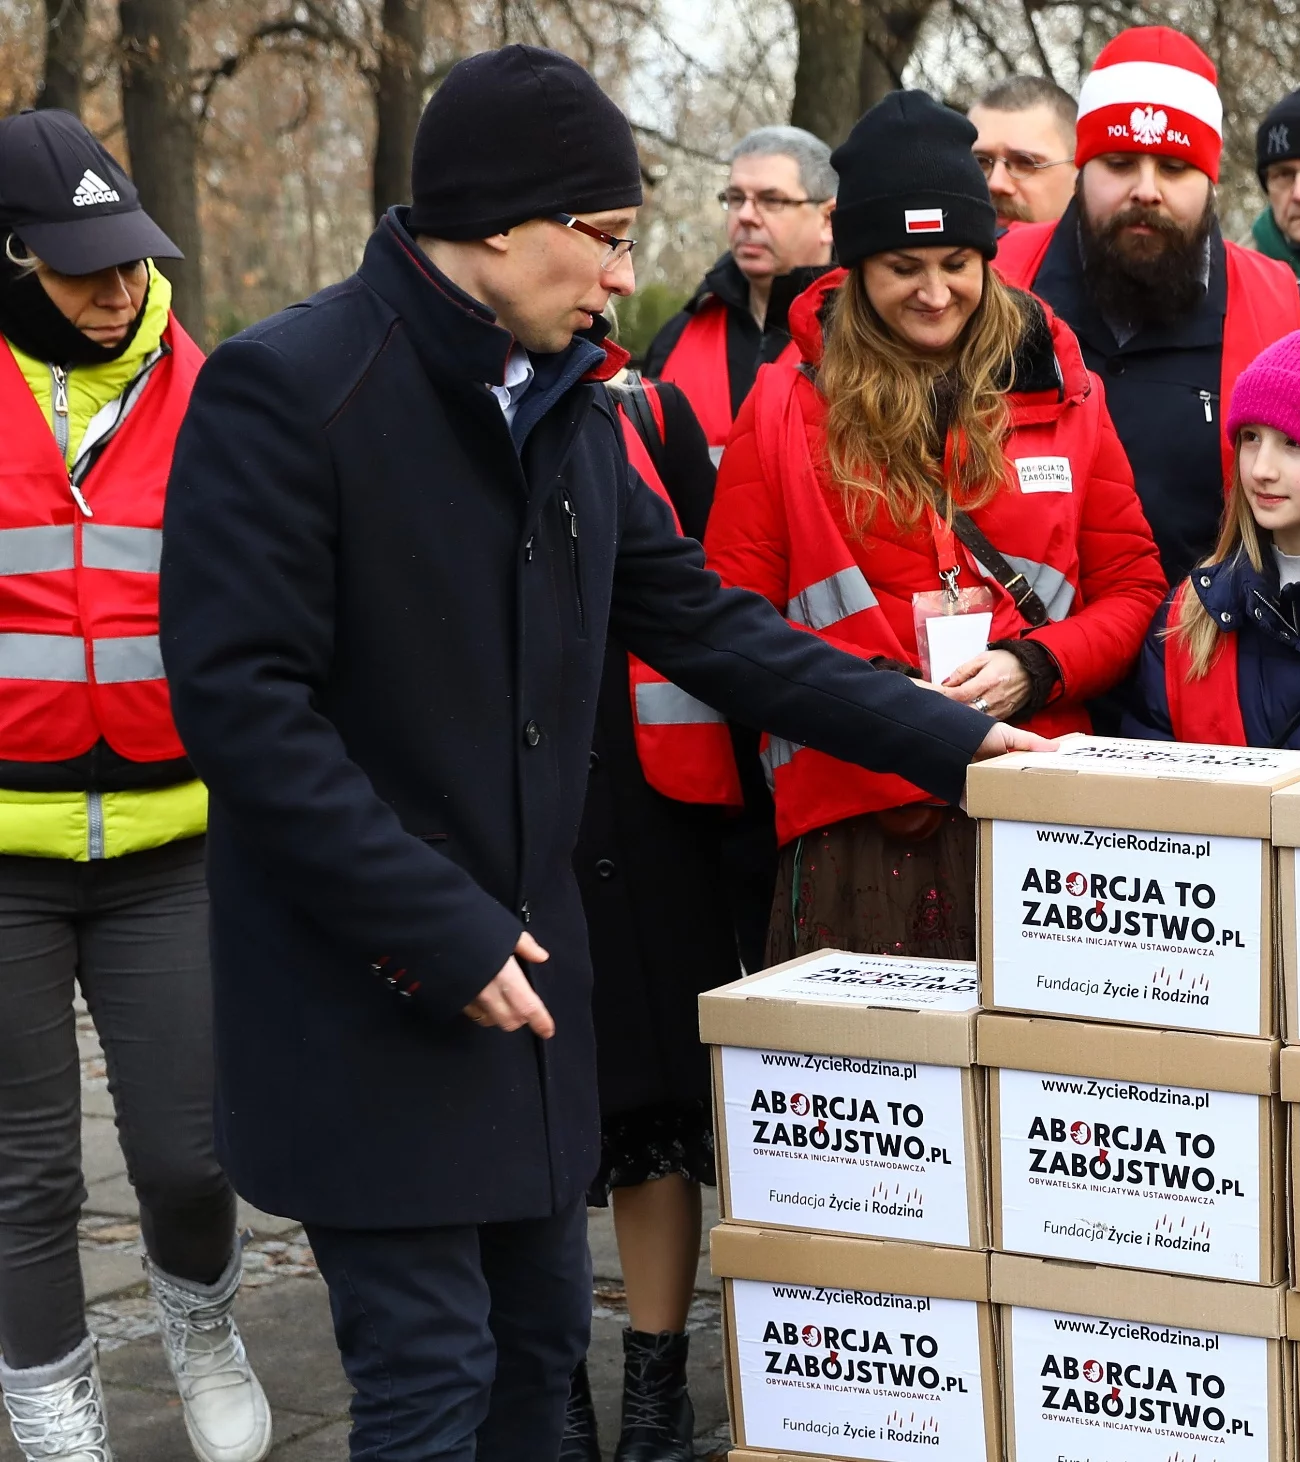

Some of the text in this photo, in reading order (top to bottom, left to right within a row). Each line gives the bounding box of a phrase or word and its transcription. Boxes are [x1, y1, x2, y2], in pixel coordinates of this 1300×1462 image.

[1107, 125, 1190, 147] POL SKA
[72, 189, 120, 207] adidas
[1037, 829, 1211, 858] www.ZycieRodzina.pl
[1021, 868, 1216, 909] ABORCJA TO
[1022, 900, 1245, 948] ZABÓJSTWO.PL
[1021, 931, 1215, 956] OBYWATELSKA INICJATYWA USTAWODAWCZA
[819, 967, 947, 983] ABORCJA
[1036, 975, 1209, 1005] Fundacja Życie i Rodzina
[761, 1053, 917, 1080] www.ZycieRodzina.pl
[750, 1089, 924, 1127] ABORCJA TO
[1042, 1079, 1209, 1109] www.ZycieRodzina.pl
[753, 1119, 952, 1164] ZABÓJSTWO.PL
[1028, 1116, 1215, 1158] ABORCJA TO
[753, 1148, 926, 1172] OBYWATELSKA INICJATYWA USTAWODAWCZA
[1029, 1149, 1244, 1196] ZABÓJSTWO.PL
[769, 1190, 923, 1218] Fundacja Życie i Rodzina
[1029, 1177, 1215, 1205] OBYWATELSKA INICJATYWA USTAWODAWCZA
[1043, 1220, 1210, 1252] Fundacja Życie i Rodzina
[773, 1287, 930, 1313] www.ZycieRodzina.pl
[763, 1321, 938, 1358] ABORCJA TO
[1054, 1319, 1219, 1351] www.ZycieRodzina.pl
[765, 1351, 968, 1393] ZABÓJSTWO.PL
[1040, 1354, 1225, 1399] ABORCJA TO
[765, 1378, 941, 1401] OBYWATELSKA INICJATYWA USTAWODAWCZA
[1042, 1386, 1254, 1437] ZABÓJSTWO.PL
[783, 1418, 940, 1445] Fundacja Życie i Rodzina
[1042, 1413, 1225, 1444] OBYWATELSKA INICJATYWA USTAWODAWCZA
